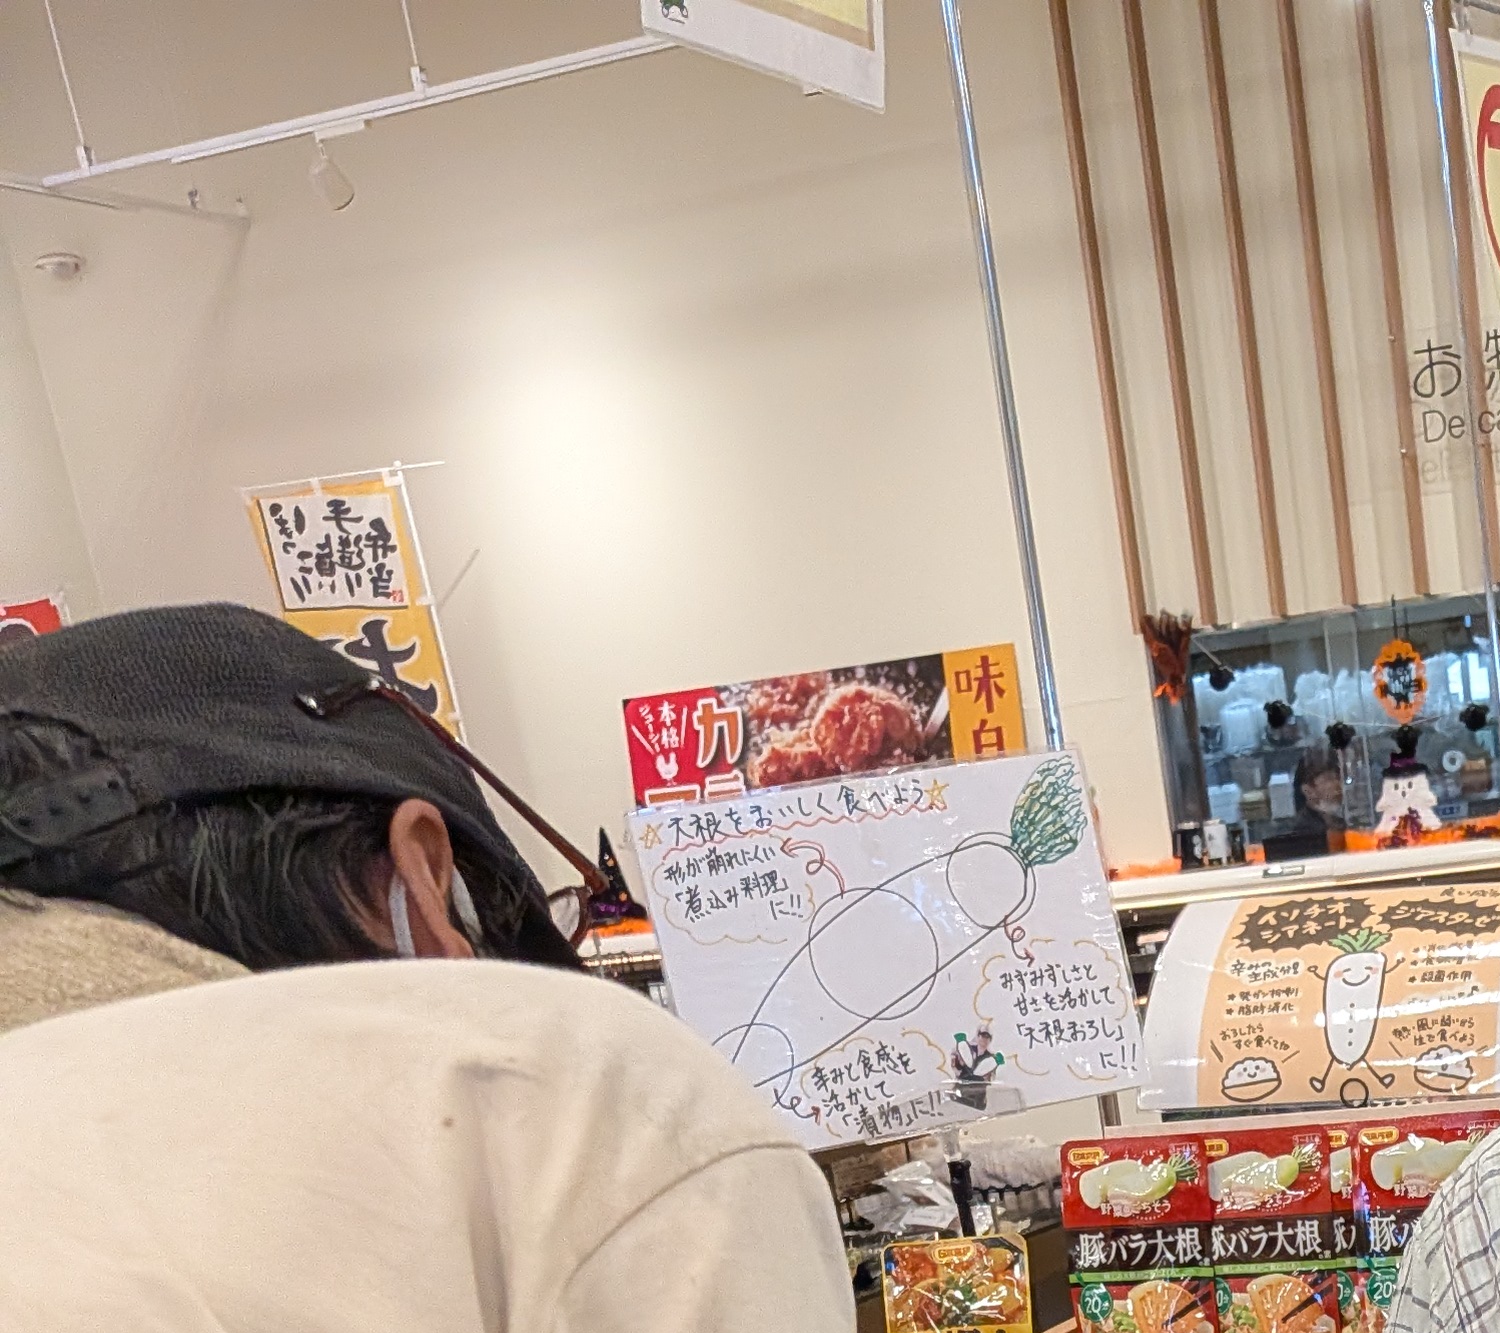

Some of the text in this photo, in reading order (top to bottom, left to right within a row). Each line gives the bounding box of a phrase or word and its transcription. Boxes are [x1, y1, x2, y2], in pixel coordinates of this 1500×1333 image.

[658, 700, 680, 750] 本格
[1257, 902, 1350, 927] イソチオ
[1260, 916, 1354, 943] シアネート
[1000, 964, 1097, 992] みずみずしさと
[821, 1081, 894, 1117] 活かして
[1078, 1227, 1203, 1268] 豚バラ大根
